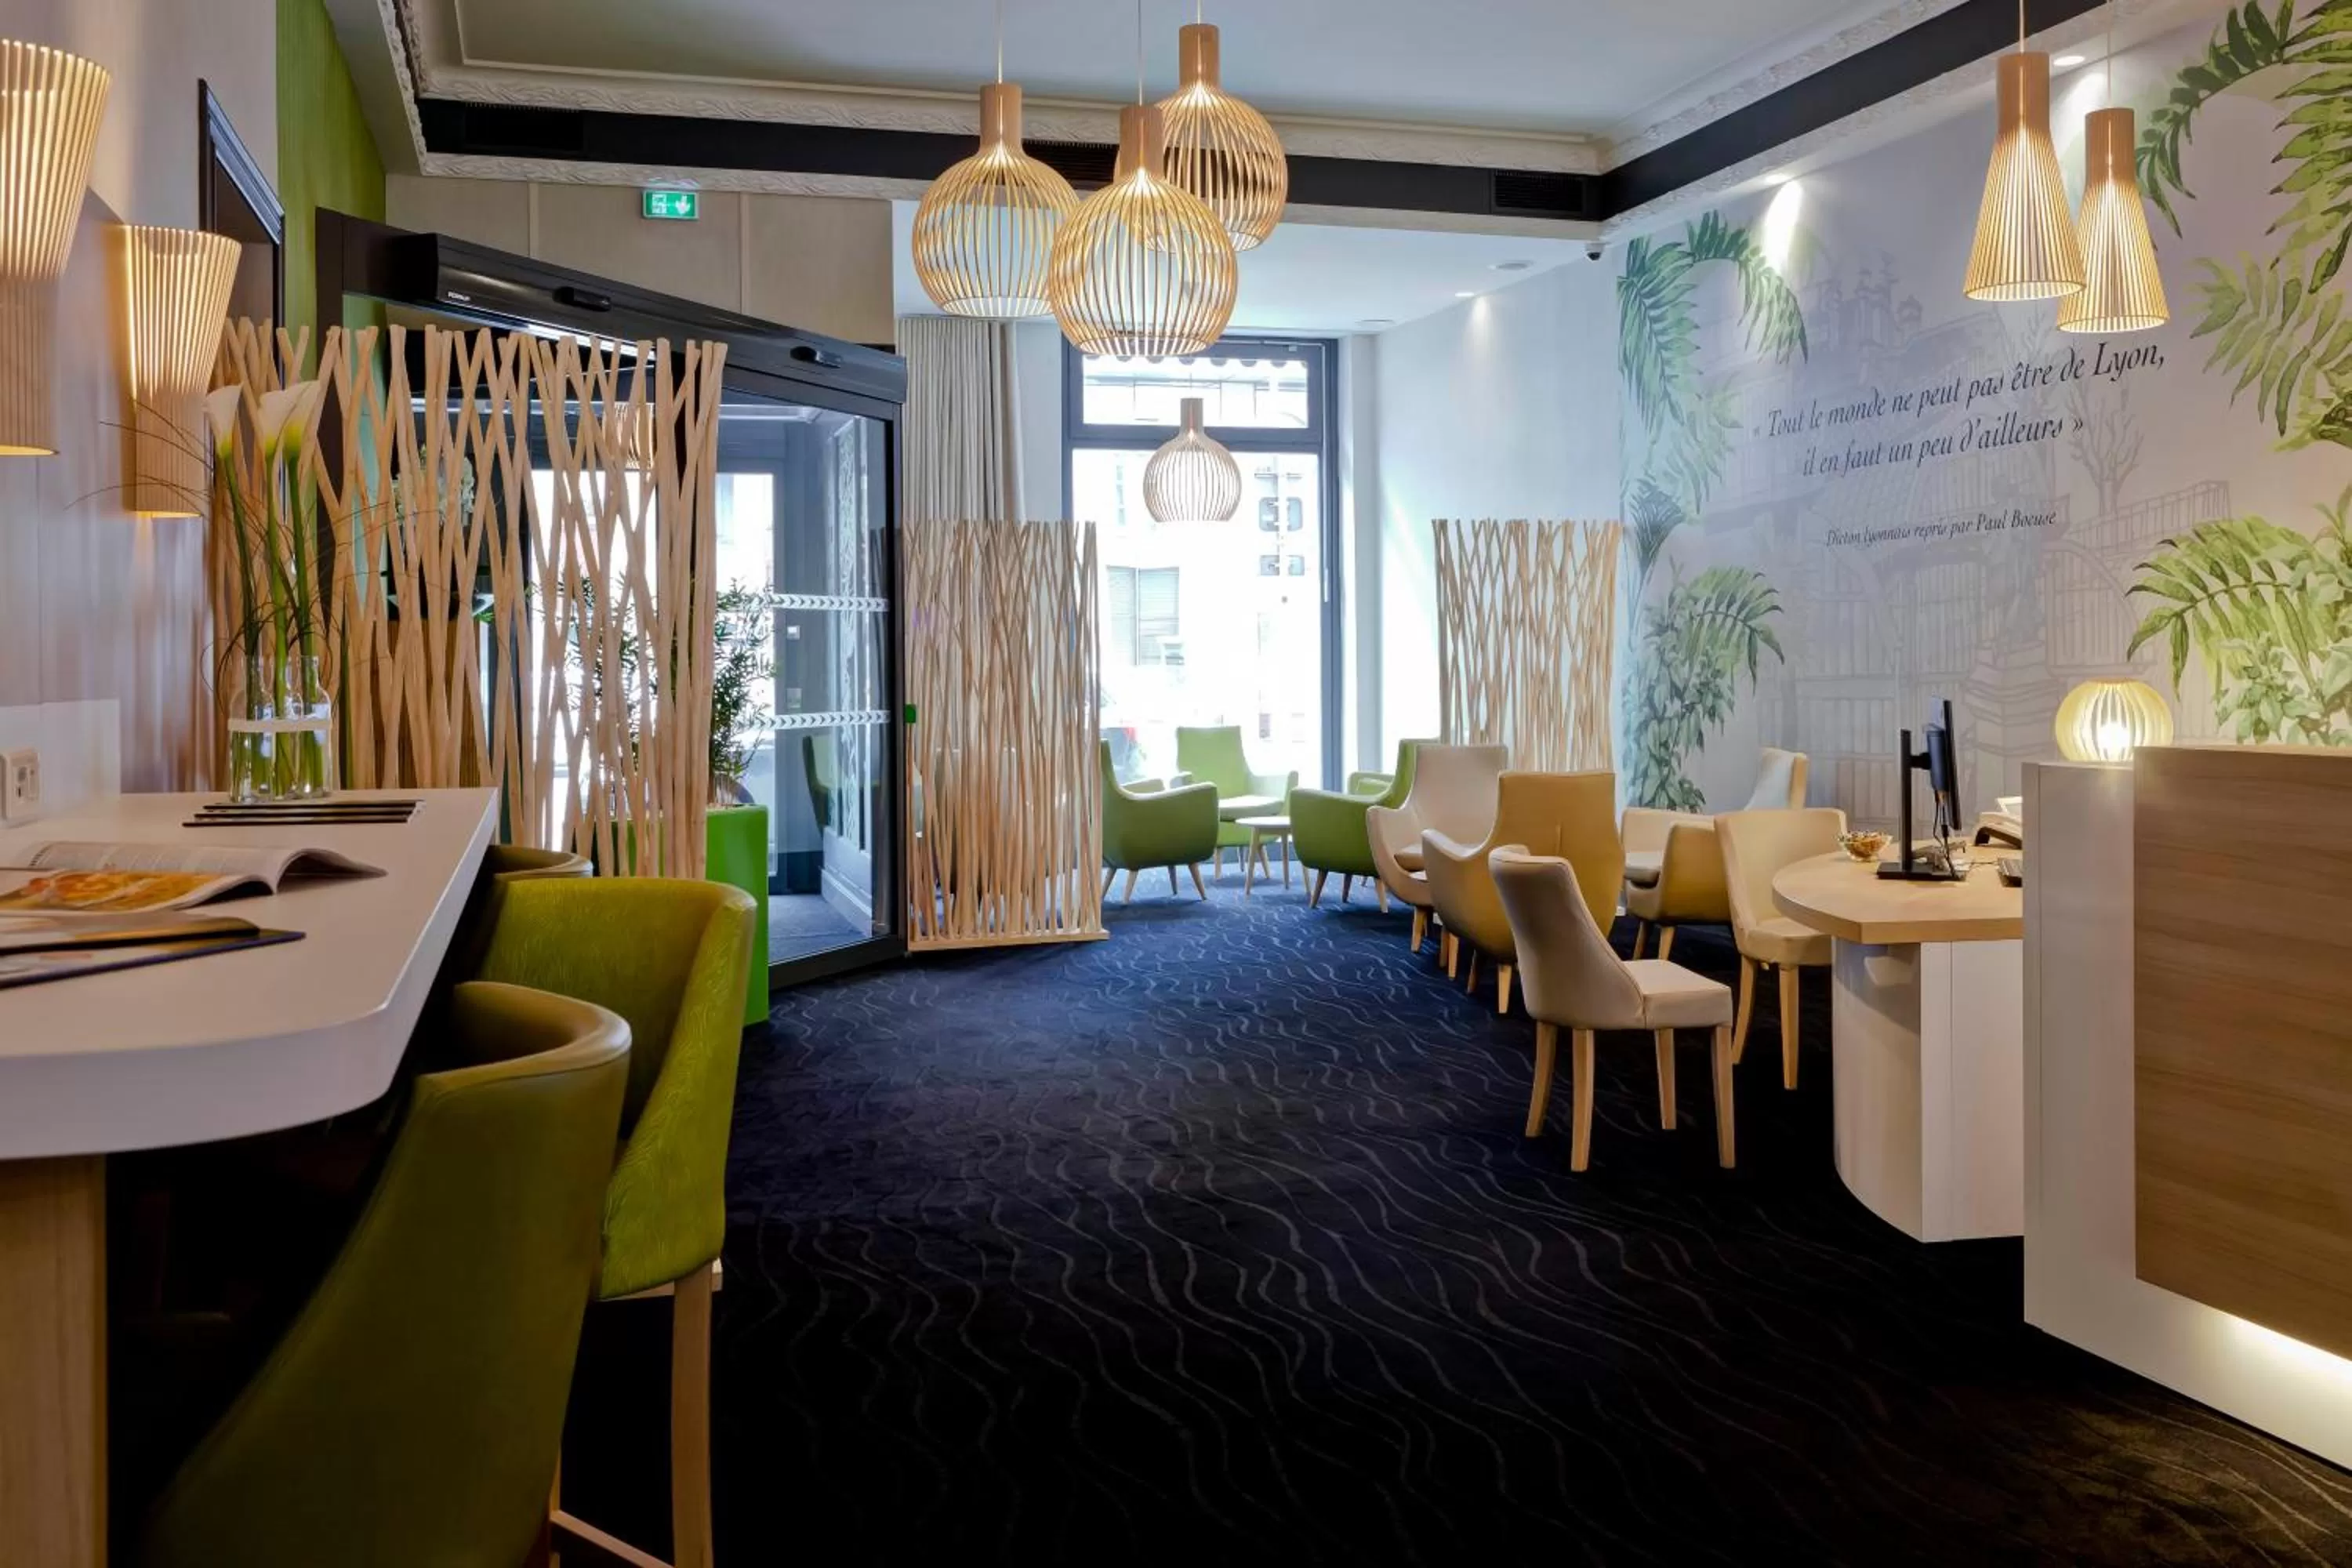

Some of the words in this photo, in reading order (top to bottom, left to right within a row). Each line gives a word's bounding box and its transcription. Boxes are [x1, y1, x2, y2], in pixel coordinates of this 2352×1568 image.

[1769, 408, 1804, 436] Tout
[1809, 398, 1823, 430] le
[1828, 386, 1886, 426] monde
[1892, 392, 1913, 414] ne
[1916, 376, 1961, 418] peut
[1965, 372, 2005, 409] pas
[2011, 361, 2053, 391] être
[2060, 345, 2085, 382] de
[2092, 342, 2164, 382] Lyon,
[1803, 445, 1817, 477] il
[1819, 452, 1838, 473] en
[1842, 439, 1882, 479] faut
[1888, 441, 1912, 463] un
[1916, 435, 1954, 468] peu
[1959, 411, 2063, 452] d'ailleurs
[1827, 528, 1861, 547] Dicton
[1863, 524, 1911, 547] lyonnais
[1914, 517, 1947, 543] repris
[1948, 521, 1973, 540] par
[1976, 509, 2008, 532] Paul
[2011, 509, 2056, 527] Bocuse
